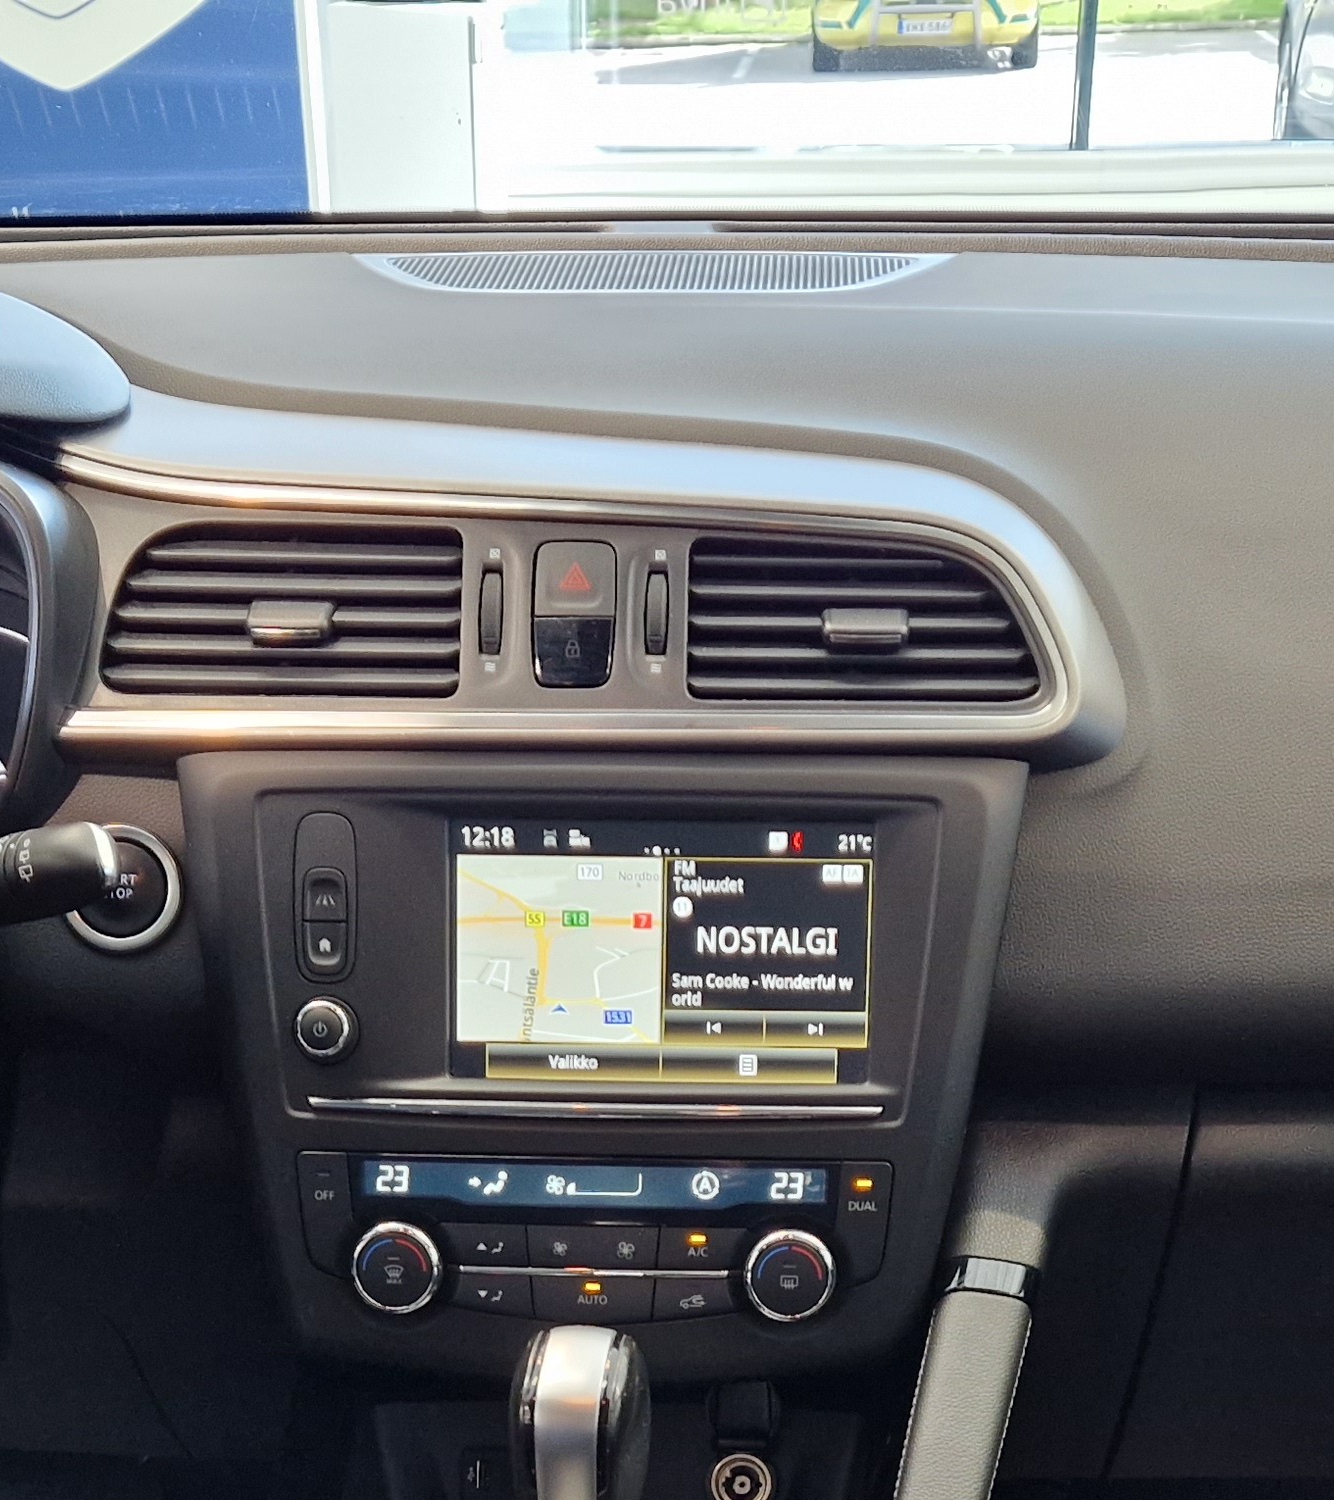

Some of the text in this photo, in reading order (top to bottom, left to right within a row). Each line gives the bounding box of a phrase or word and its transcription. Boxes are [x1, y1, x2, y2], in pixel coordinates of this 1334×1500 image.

[462, 826, 516, 848] 12:18
[580, 866, 600, 878] 170
[674, 860, 696, 876] FM
[618, 870, 660, 882] Nordbo
[673, 877, 745, 897] Taajuudet
[564, 913, 587, 925] E18
[639, 915, 648, 928] 7
[696, 926, 839, 956] NOSTALGI
[672, 972, 703, 988] Sam
[705, 973, 750, 989] Cooke
[760, 974, 836, 991] Wonderful
[839, 976, 854, 991] w
[548, 1054, 599, 1070] Valikko
[376, 1164, 410, 1193] 23
[770, 1171, 805, 1200] 23
[314, 1189, 335, 1201] OFF
[848, 1200, 878, 1212] DUAL
[687, 1246, 709, 1258] A/C
[577, 1294, 608, 1306] AUTO
